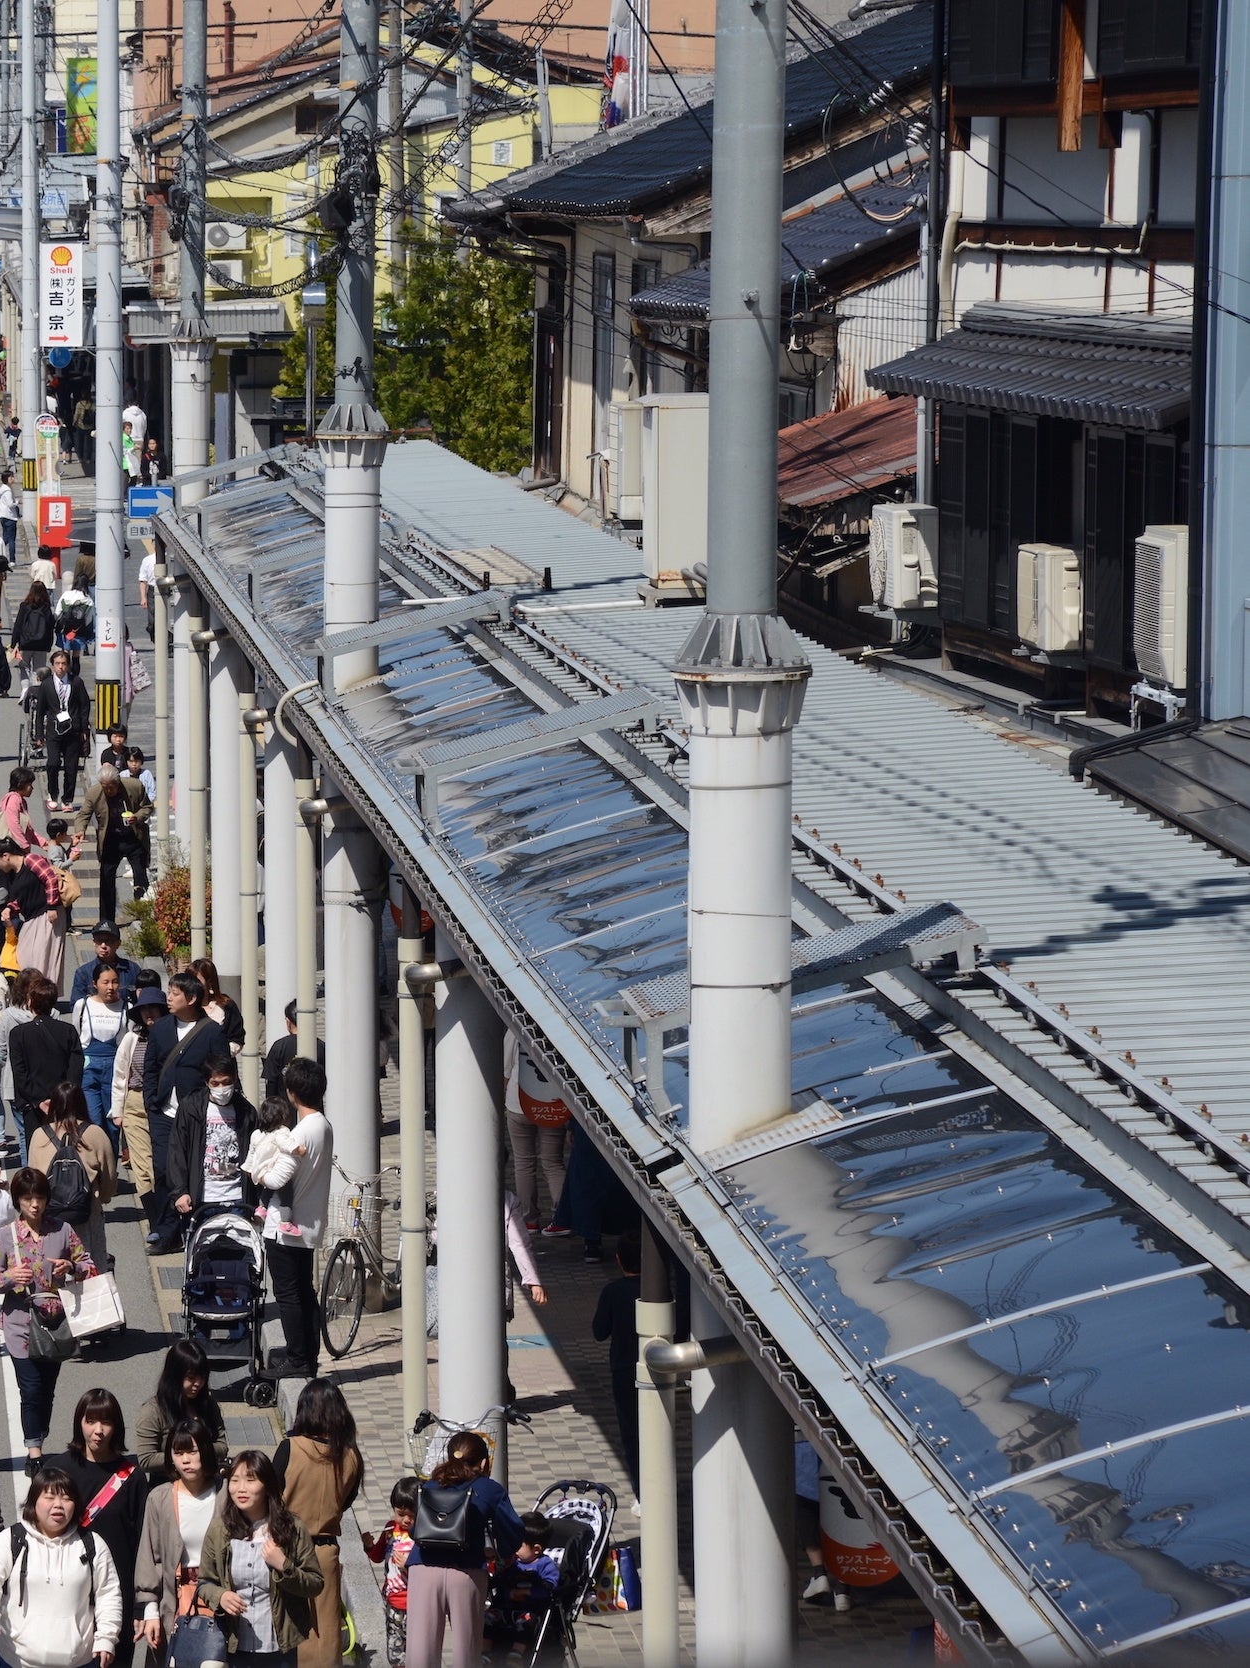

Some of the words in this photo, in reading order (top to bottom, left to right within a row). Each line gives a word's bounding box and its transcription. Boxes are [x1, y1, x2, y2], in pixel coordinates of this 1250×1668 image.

[66, 277, 76, 317] ガソリン
[533, 1113, 566, 1121] アベニュー
[836, 1555, 893, 1565] サンストーク
[840, 1565, 888, 1576] アベニュー
